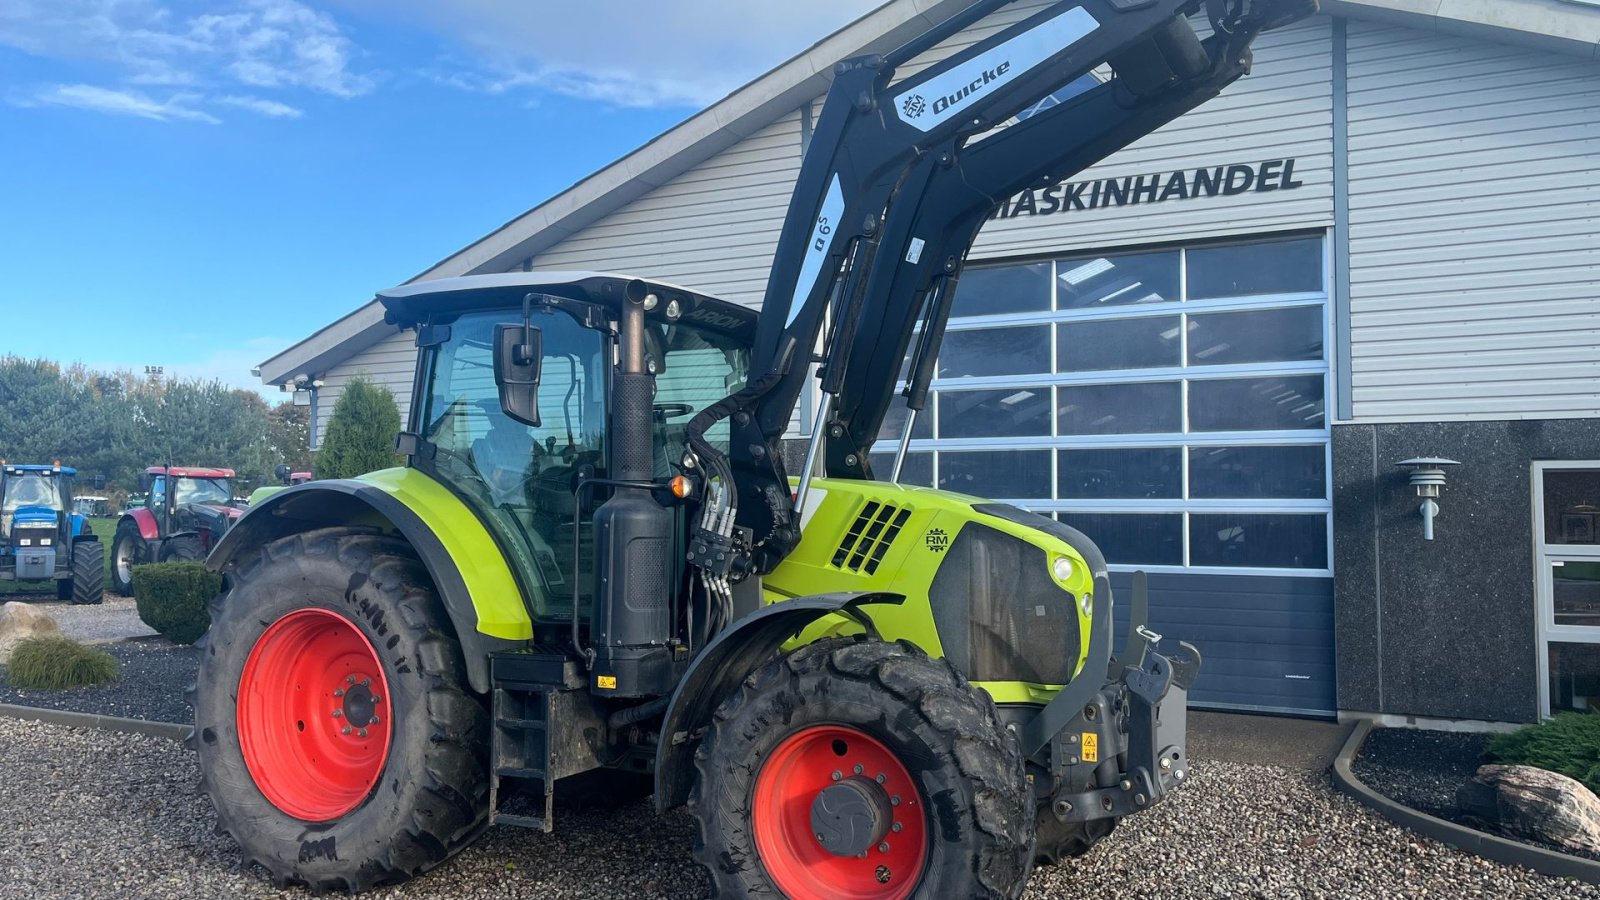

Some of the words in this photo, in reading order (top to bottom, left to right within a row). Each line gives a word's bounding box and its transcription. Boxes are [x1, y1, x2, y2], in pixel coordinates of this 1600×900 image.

[905, 94, 924, 119] RM
[932, 60, 1011, 115] Quicke
[926, 535, 948, 545] RM
